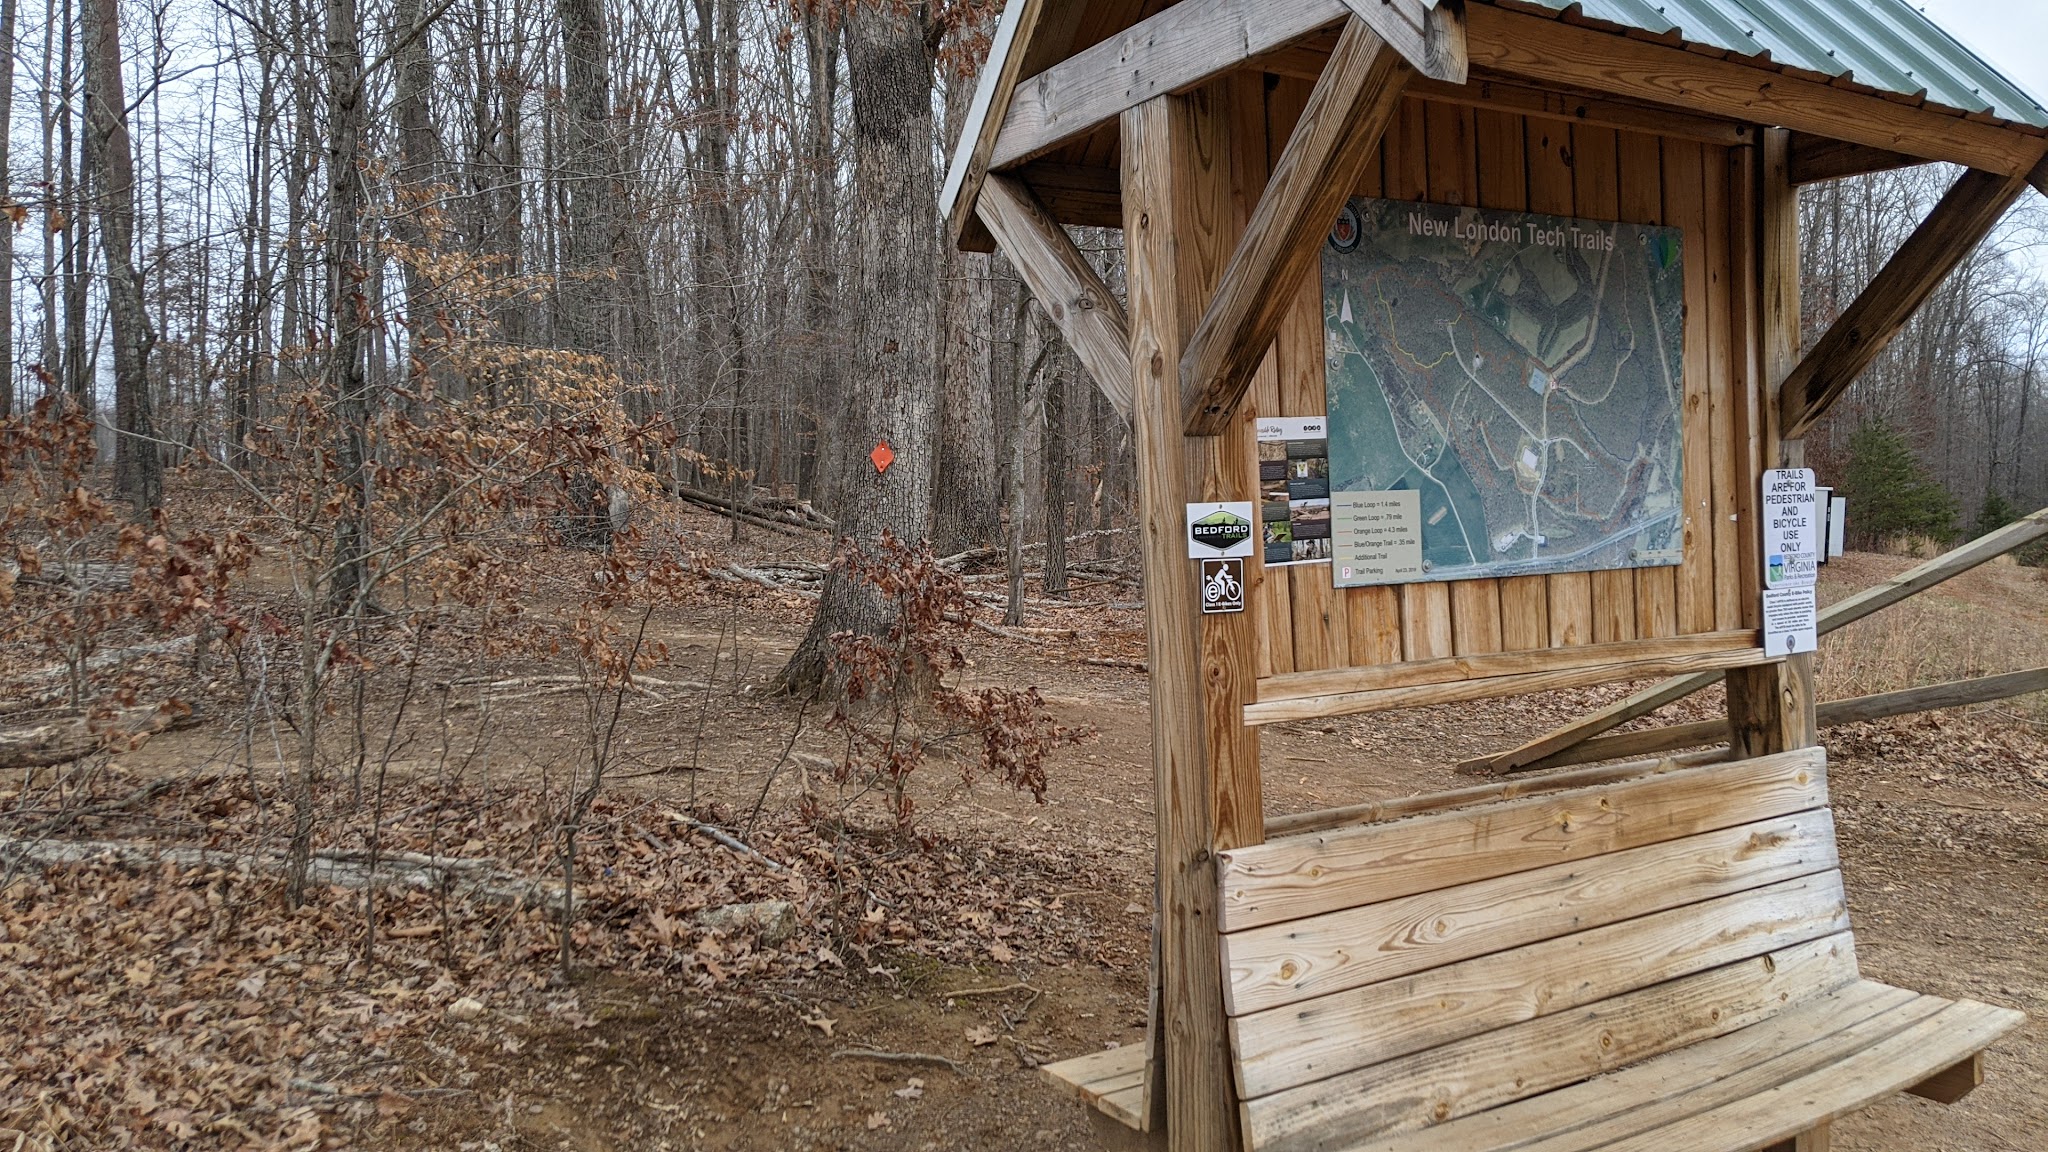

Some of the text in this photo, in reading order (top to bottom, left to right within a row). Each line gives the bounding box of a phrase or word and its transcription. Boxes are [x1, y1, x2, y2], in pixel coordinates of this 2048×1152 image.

[1408, 212, 1614, 251] New London Tech Trails
[1341, 269, 1349, 280] N
[1776, 470, 1804, 480] TRAILS
[1771, 482, 1806, 492] ARE FOR
[1766, 494, 1815, 504] PEDESTRIAN
[1782, 506, 1798, 516] AND
[1773, 518, 1807, 528] BICYCLE
[1194, 526, 1248, 534] BEDFORD
[1783, 530, 1799, 540] USE
[1780, 542, 1801, 552] ONLY
[1784, 560, 1816, 573] VIRGINIA
